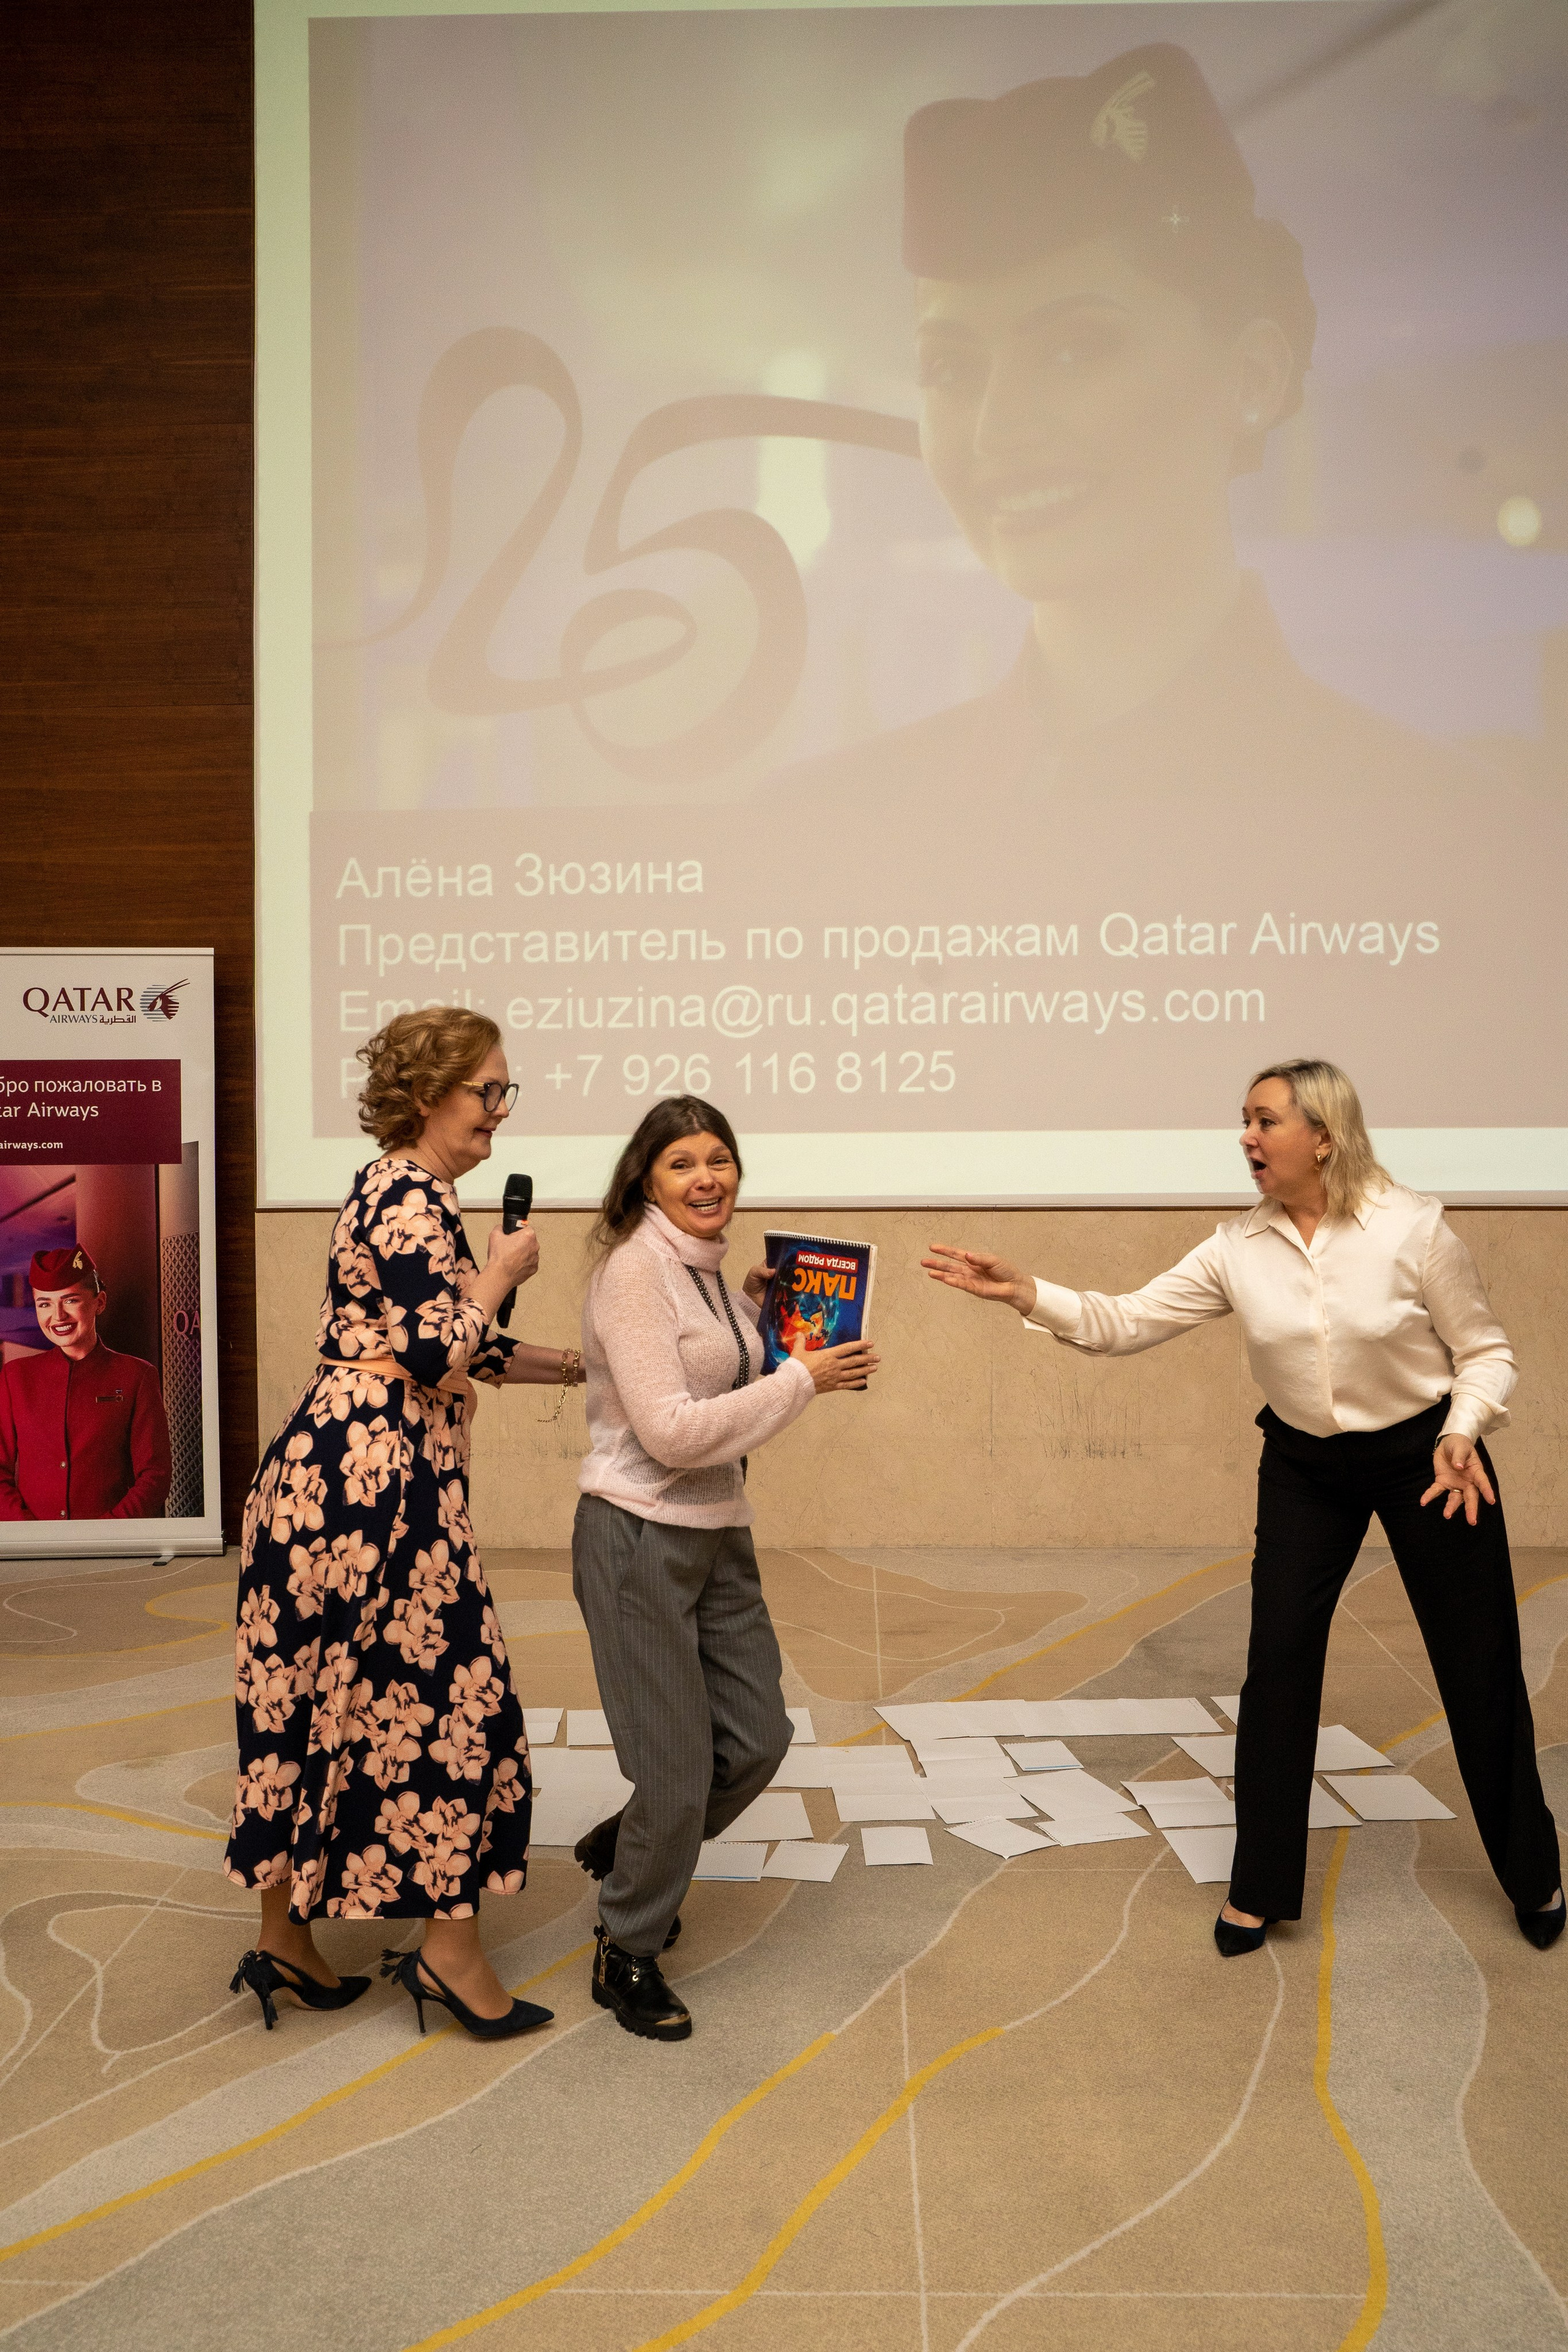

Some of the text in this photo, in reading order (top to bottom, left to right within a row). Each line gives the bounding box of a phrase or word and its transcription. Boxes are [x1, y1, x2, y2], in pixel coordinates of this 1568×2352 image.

[336, 853, 703, 898] Алёна Зюзина
[339, 912, 1440, 976] Представитель по продажам Qatar Airways
[23, 987, 136, 1018] QATAR
[341, 981, 1265, 1039] Eml: eziuzina@ru.qatarairways.com
[50, 1014, 98, 1023] AIRWAYS
[99, 1014, 137, 1025] القطرية
[34, 1080, 147, 1093] пожаловать
[152, 1080, 162, 1093] в
[545, 1054, 603, 1096] +7
[623, 1053, 711, 1096] 926
[736, 1052, 816, 1095] 116
[836, 1050, 956, 1093] 8125
[27, 1102, 99, 1121] Airways
[797, 1254, 856, 1270] ВСЕГДА РЯДОМ
[791, 1267, 858, 1300] ПАКС
